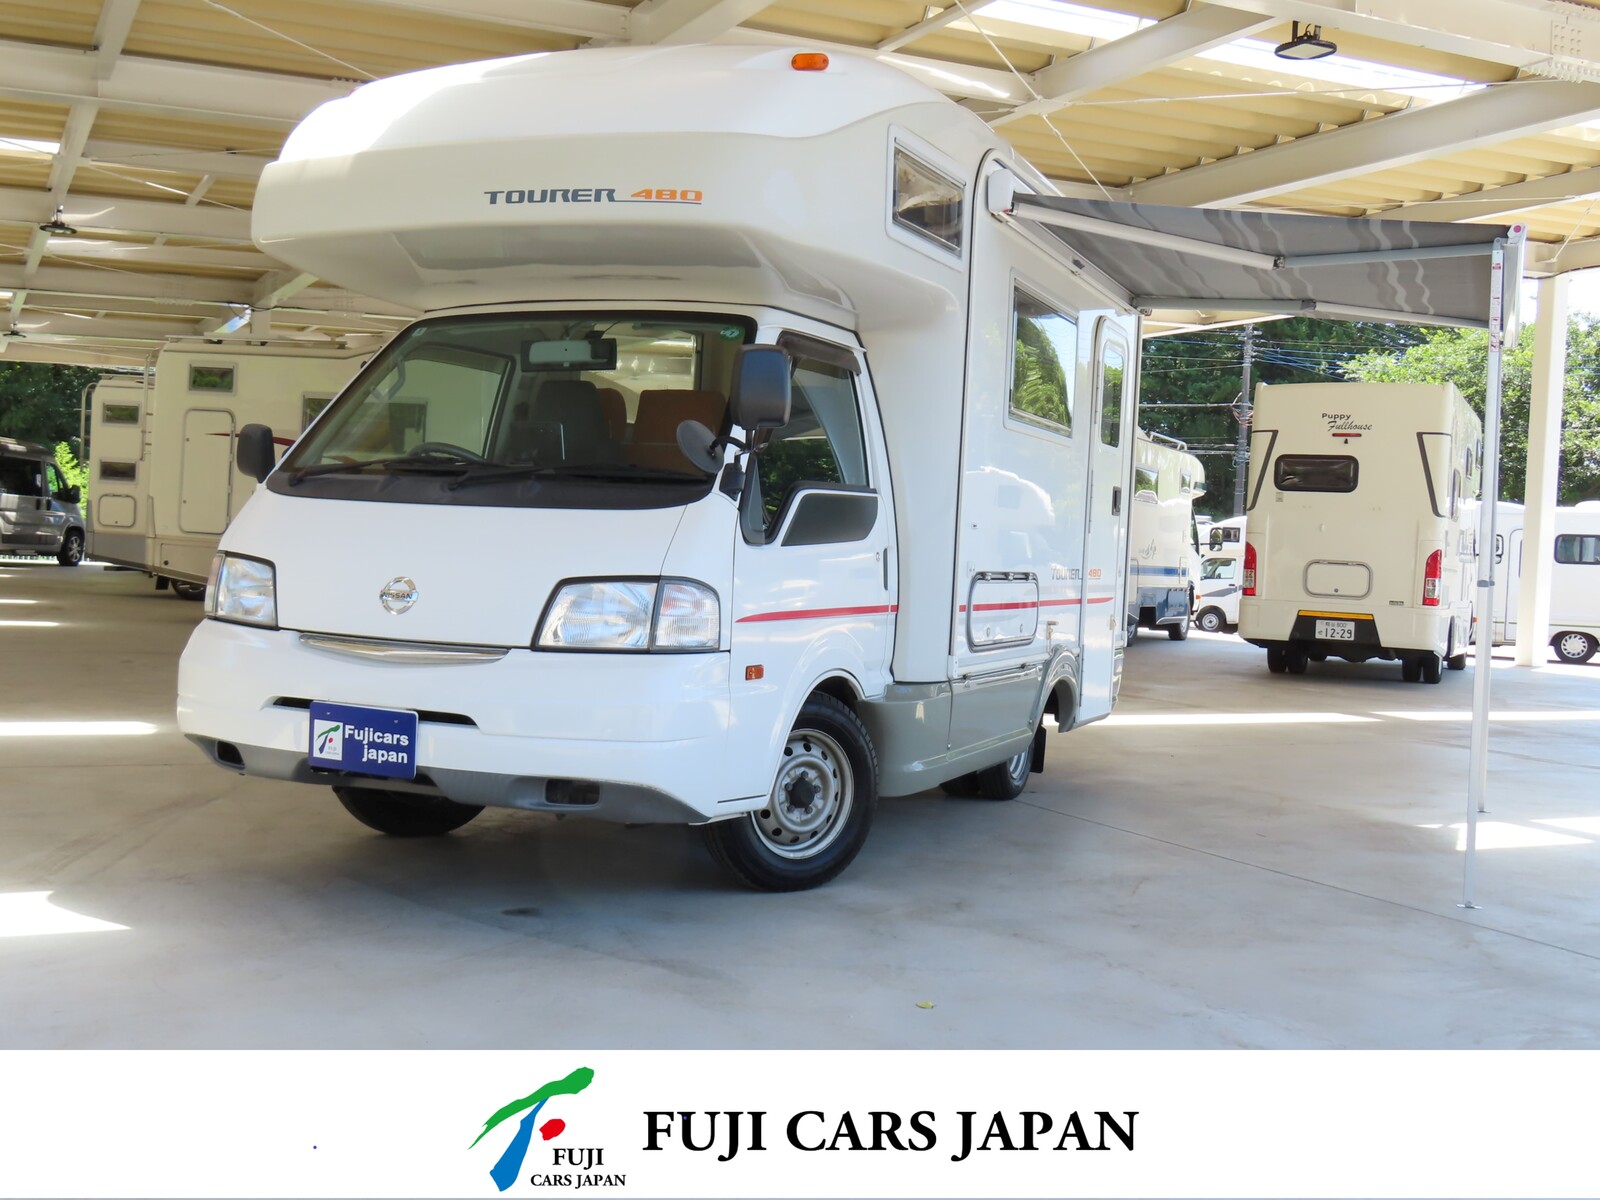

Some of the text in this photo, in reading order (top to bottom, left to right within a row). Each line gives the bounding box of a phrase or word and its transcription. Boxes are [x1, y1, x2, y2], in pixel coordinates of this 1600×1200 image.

[484, 188, 703, 205] TOURER 480
[1321, 412, 1352, 421] Puppy
[1327, 419, 1373, 432] Fullhouse
[1087, 568, 1102, 578] 480
[1325, 628, 1352, 639] 12-29
[344, 725, 409, 746] Fujicars
[362, 745, 408, 763] japan
